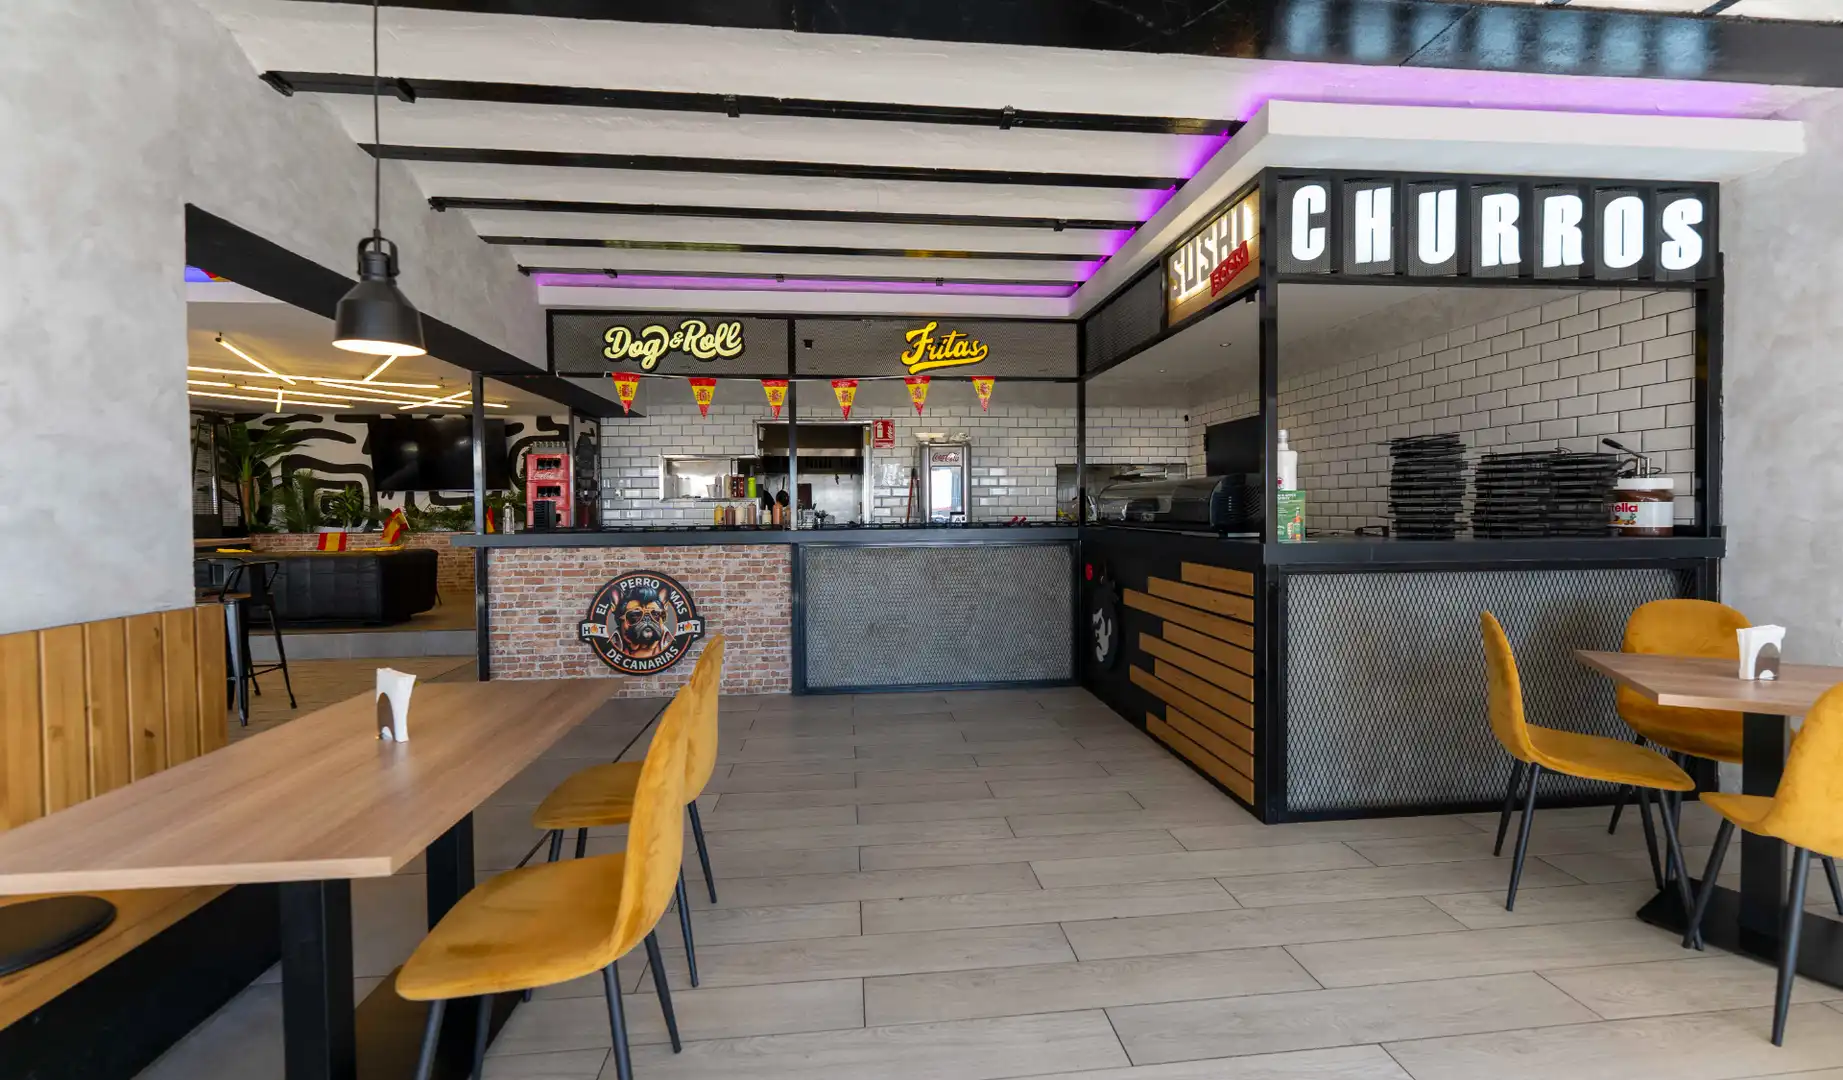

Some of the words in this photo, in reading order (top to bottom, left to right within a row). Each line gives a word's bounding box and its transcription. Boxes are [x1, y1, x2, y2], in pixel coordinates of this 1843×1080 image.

[1167, 203, 1246, 300] SUSHI
[1291, 184, 1704, 271] CHURROS
[603, 325, 670, 370] Dog
[669, 331, 684, 349] &
[680, 319, 743, 359] Roll
[901, 321, 988, 375] Fritas
[595, 602, 609, 616] EL
[619, 577, 660, 591] PERRO
[669, 590, 688, 615] MAS
[606, 648, 623, 664] DE
[622, 645, 679, 670] CANARIAS
